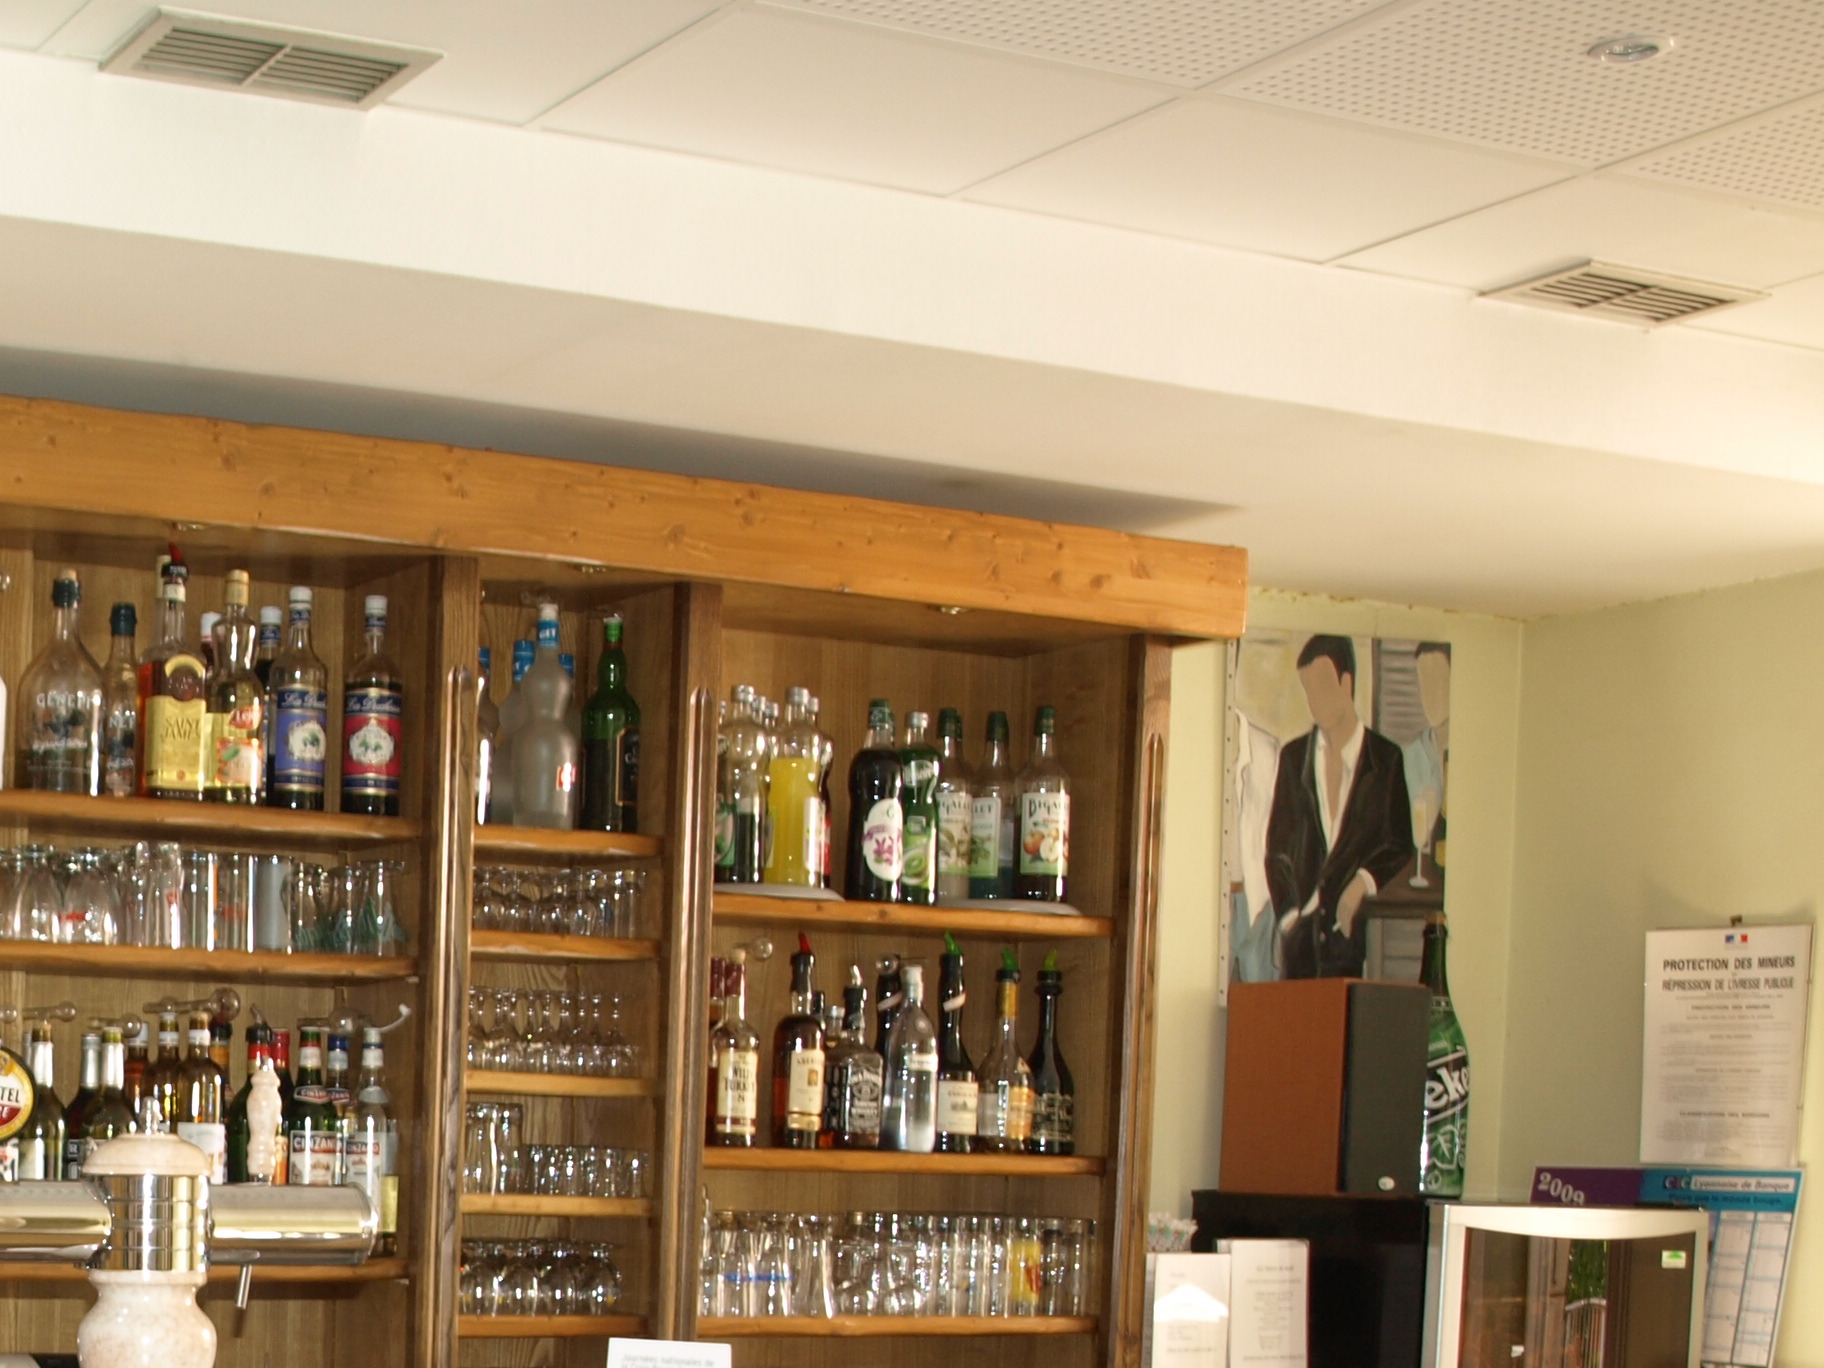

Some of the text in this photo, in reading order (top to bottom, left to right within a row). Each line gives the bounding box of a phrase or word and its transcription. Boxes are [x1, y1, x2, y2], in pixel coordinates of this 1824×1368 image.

[1663, 956, 1795, 971] PROTECTION DES MINEURS
[1715, 979, 1725, 990] DE
[1764, 977, 1794, 989] PUBLIQUE
[1536, 1171, 1585, 1205] 2009
[1694, 1177, 1738, 1190] Lyonnaise
[1741, 1179, 1752, 1188] de
[1755, 1180, 1790, 1193] Banque
[705, 1359, 715, 1367] de
